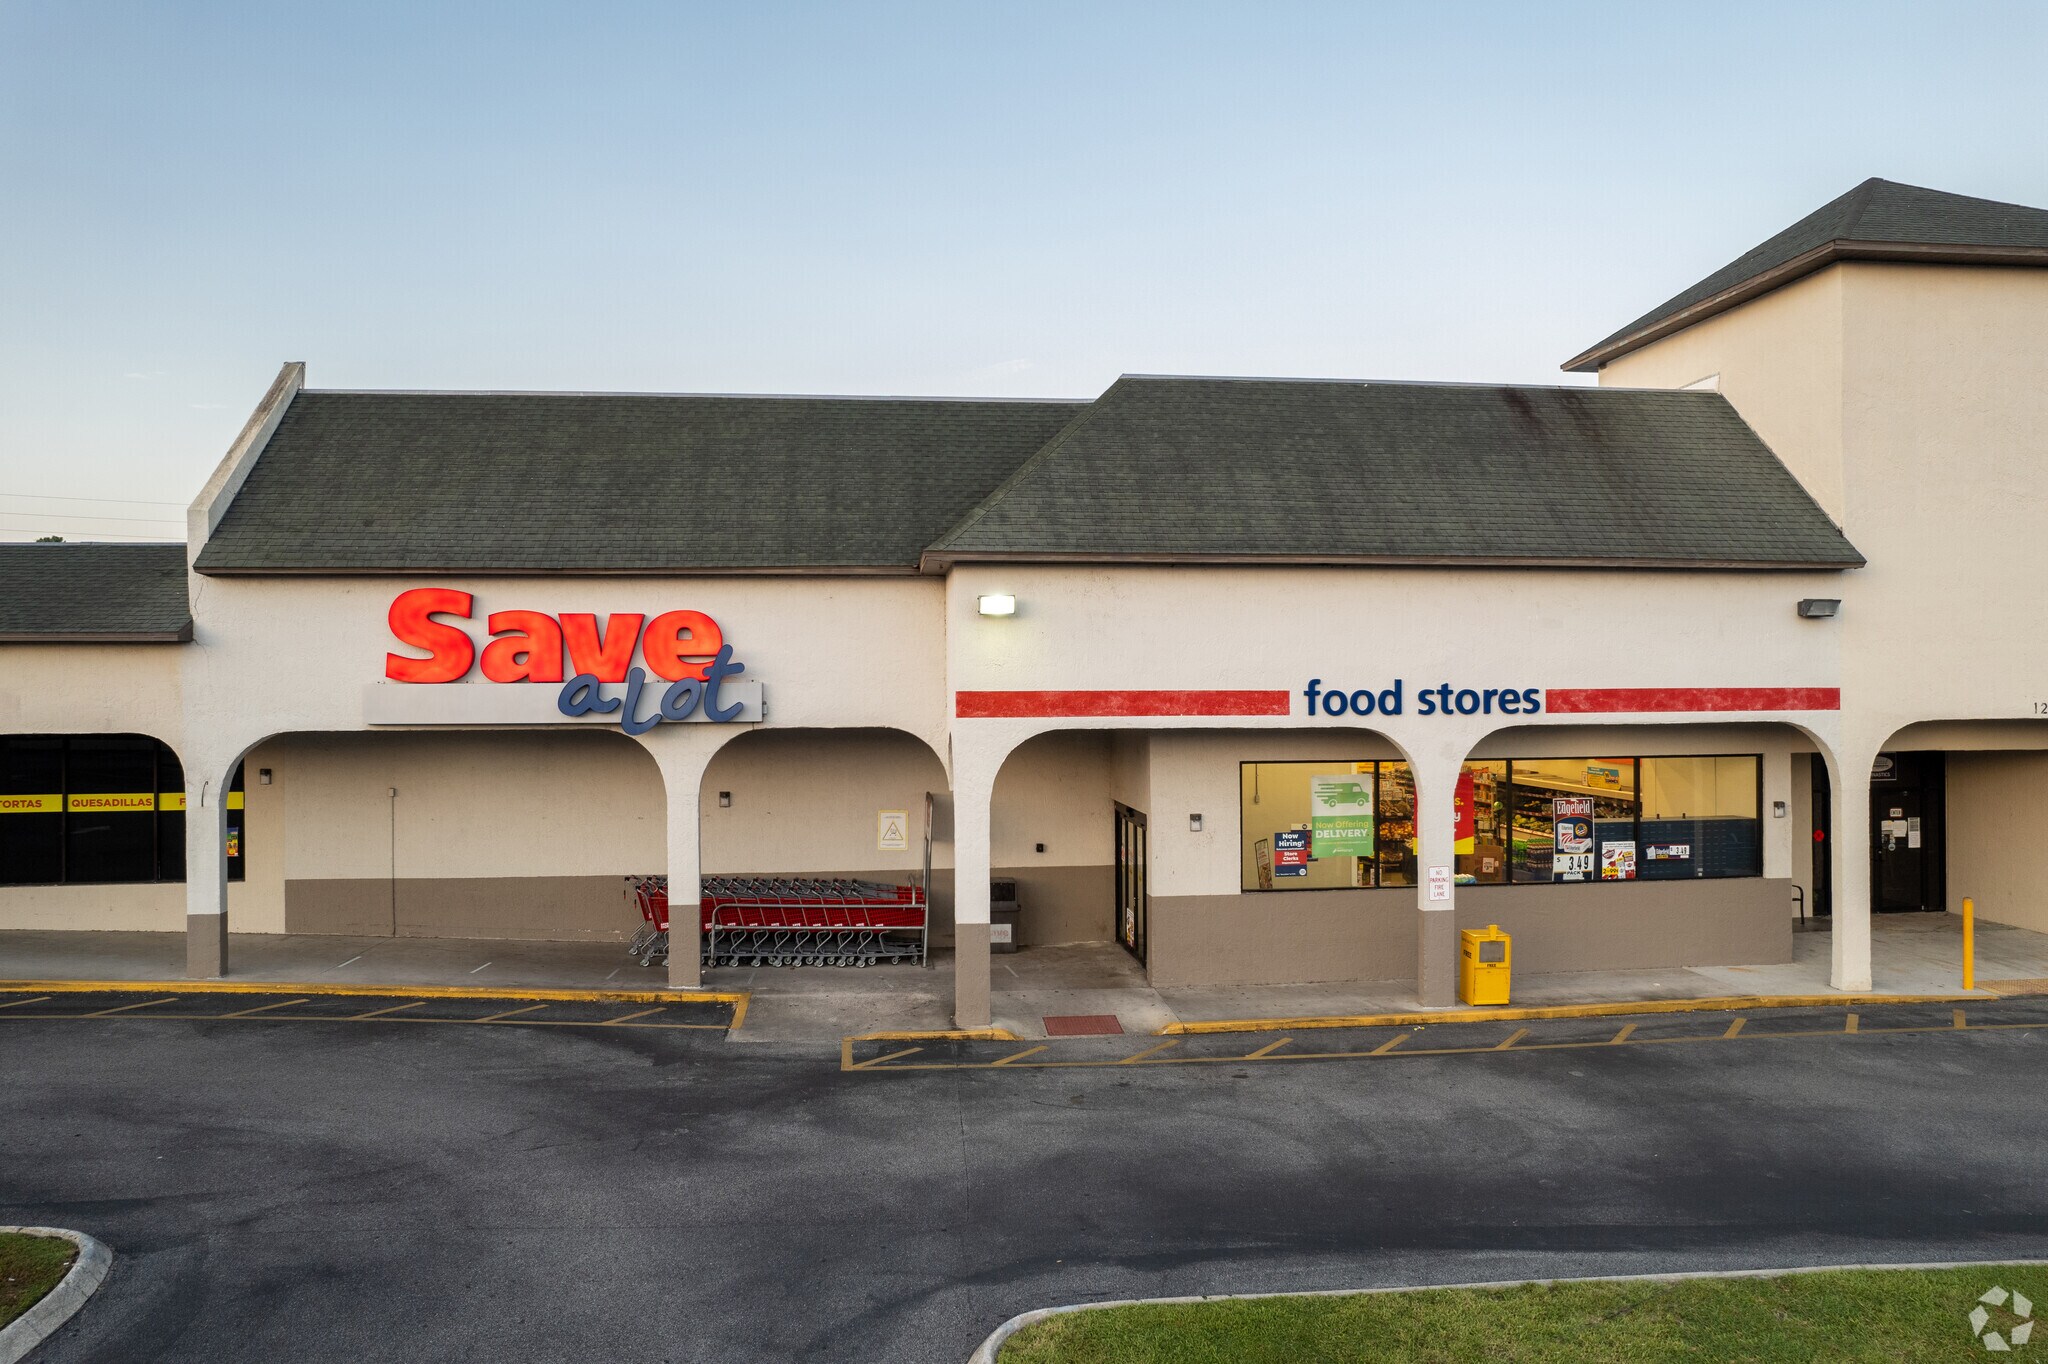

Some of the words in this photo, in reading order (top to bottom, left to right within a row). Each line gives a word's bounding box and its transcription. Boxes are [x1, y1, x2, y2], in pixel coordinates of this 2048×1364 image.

[386, 588, 723, 684] Save
[1303, 679, 1403, 716] food
[1417, 682, 1541, 715] stores
[71, 798, 153, 808] QUESADILLAS
[1556, 800, 1591, 817] Edgefield
[1315, 821, 1334, 829] Now
[1335, 820, 1369, 829] Offering
[1315, 829, 1368, 839] DELIVERY
